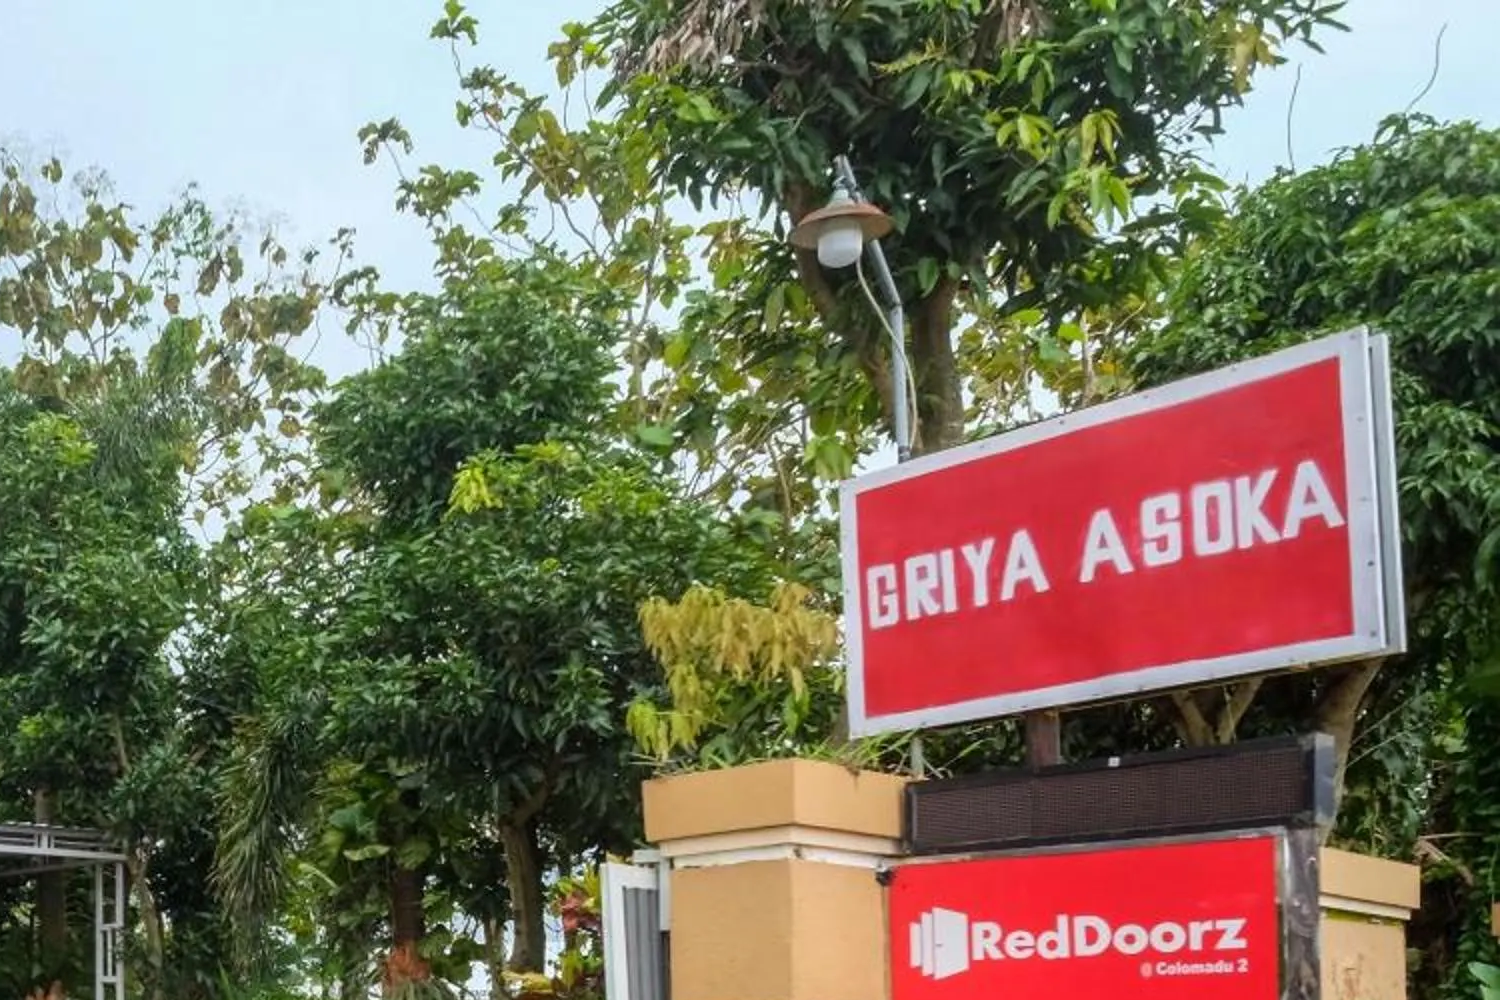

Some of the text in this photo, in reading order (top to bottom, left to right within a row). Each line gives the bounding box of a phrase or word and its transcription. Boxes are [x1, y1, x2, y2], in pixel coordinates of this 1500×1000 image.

[866, 459, 1346, 631] GRIYA ASOKA
[971, 913, 1248, 961] RedDoorz
[1156, 959, 1234, 976] Colomadu
[1237, 957, 1249, 974] 2
